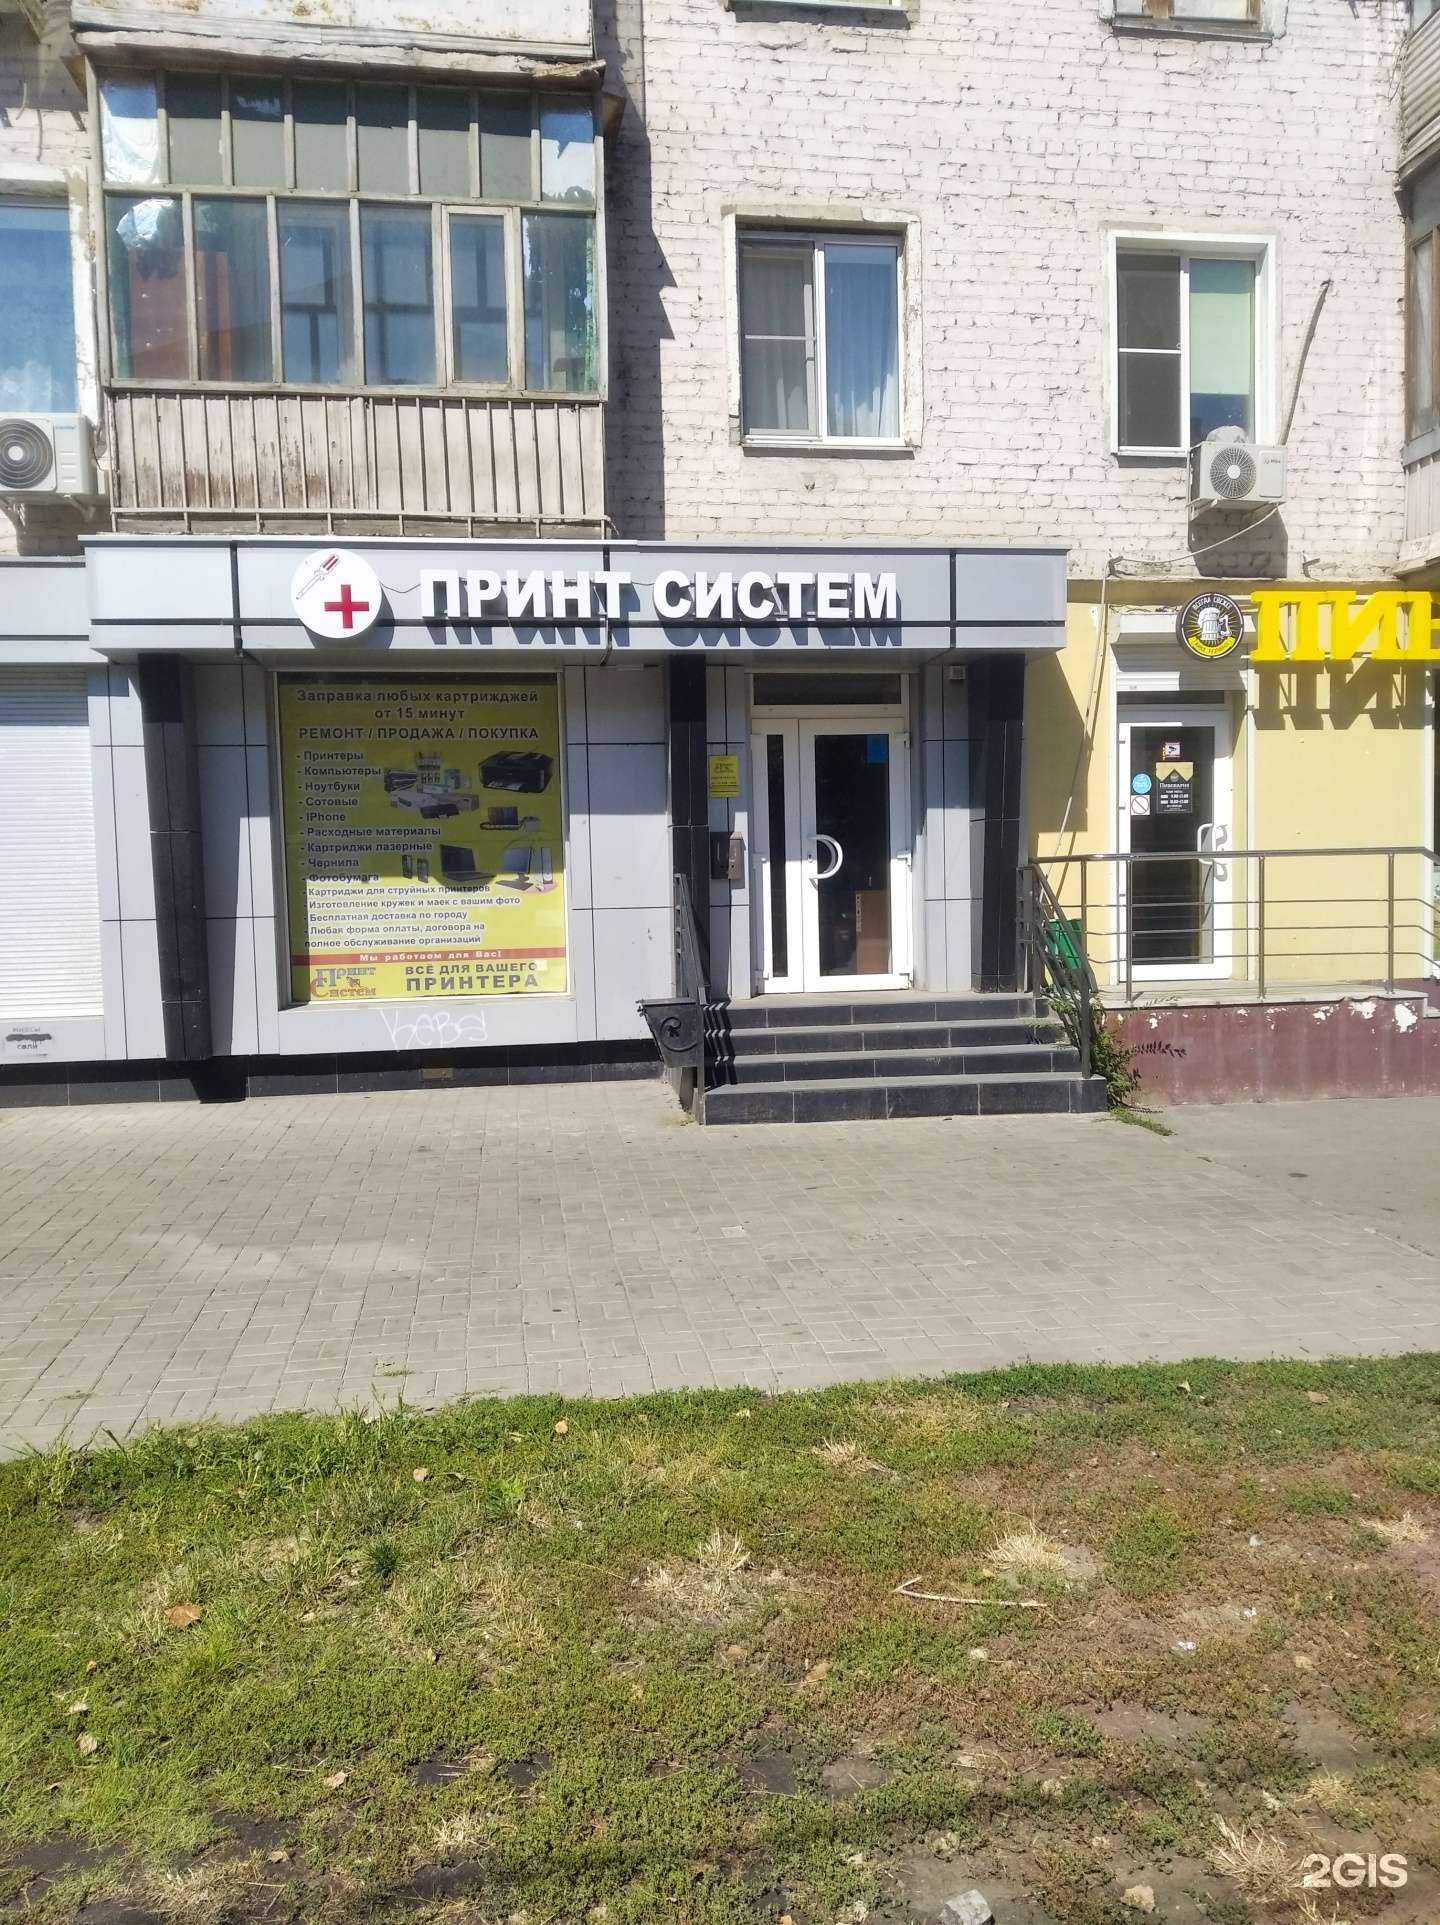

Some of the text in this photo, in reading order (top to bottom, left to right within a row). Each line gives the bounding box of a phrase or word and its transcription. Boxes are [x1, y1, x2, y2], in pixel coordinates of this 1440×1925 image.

[420, 569, 898, 620] ПРИНТ СИСТЕМ
[296, 689, 372, 704] Заправка
[376, 689, 431, 702] любых
[374, 707, 465, 722] от 15 минут
[299, 727, 364, 739] РЕМОНТ
[377, 727, 455, 740] ПРОДАЖА
[468, 727, 539, 739] ПОКУПКА
[303, 751, 364, 761] Принтеры
[304, 766, 381, 776] Компьютеры
[305, 782, 360, 793] Ноутбуки
[305, 797, 359, 806] Сотовые
[307, 827, 441, 837] Расходные материалы
[307, 843, 433, 853] Картриджи лазерные
[308, 858, 360, 868] Чернила
[309, 874, 379, 883] Фотобумага
[308, 888, 361, 897] Картриджи
[366, 887, 385, 896] для
[387, 886, 436, 896] струйных
[309, 900, 379, 909] Изготовление
[381, 899, 415, 909] кружек
[496, 897, 521, 906] фото
[309, 913, 369, 922] Бесплатная
[371, 912, 417, 921] доставка
[434, 911, 468, 920] городу
[346, 925, 380, 935] форма
[425, 924, 471, 933] договора
[343, 938, 416, 947] обслуживание
[439, 964, 470, 975] ДЛЯ
[475, 962, 537, 973] ВАШЕГО
[406, 974, 539, 992] ПРИНТЕРА
